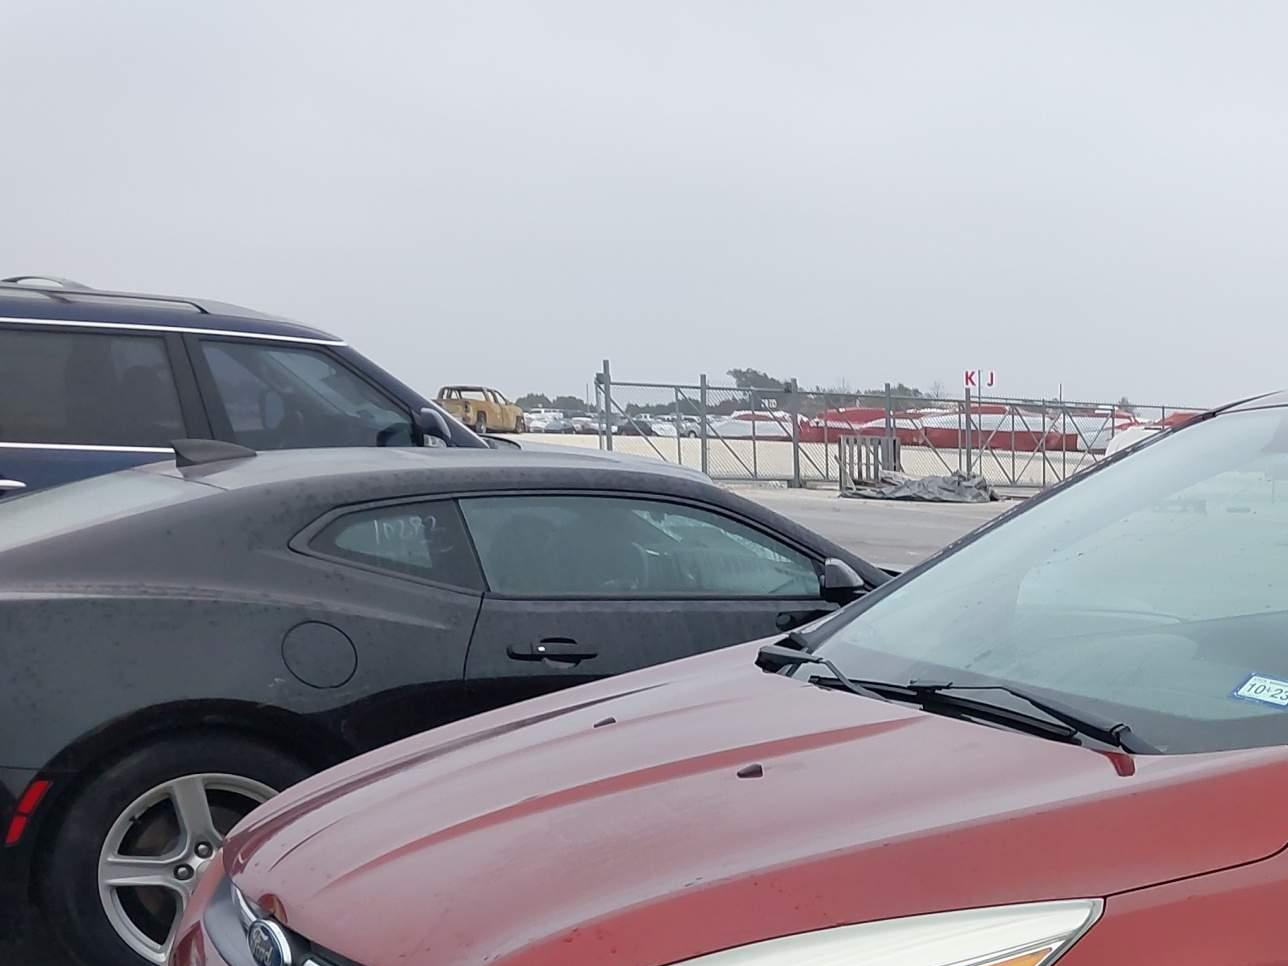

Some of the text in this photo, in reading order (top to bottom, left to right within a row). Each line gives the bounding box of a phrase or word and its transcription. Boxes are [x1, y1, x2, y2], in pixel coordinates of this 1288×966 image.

[964, 370, 995, 388] K J
[1246, 682, 1267, 695] 10
